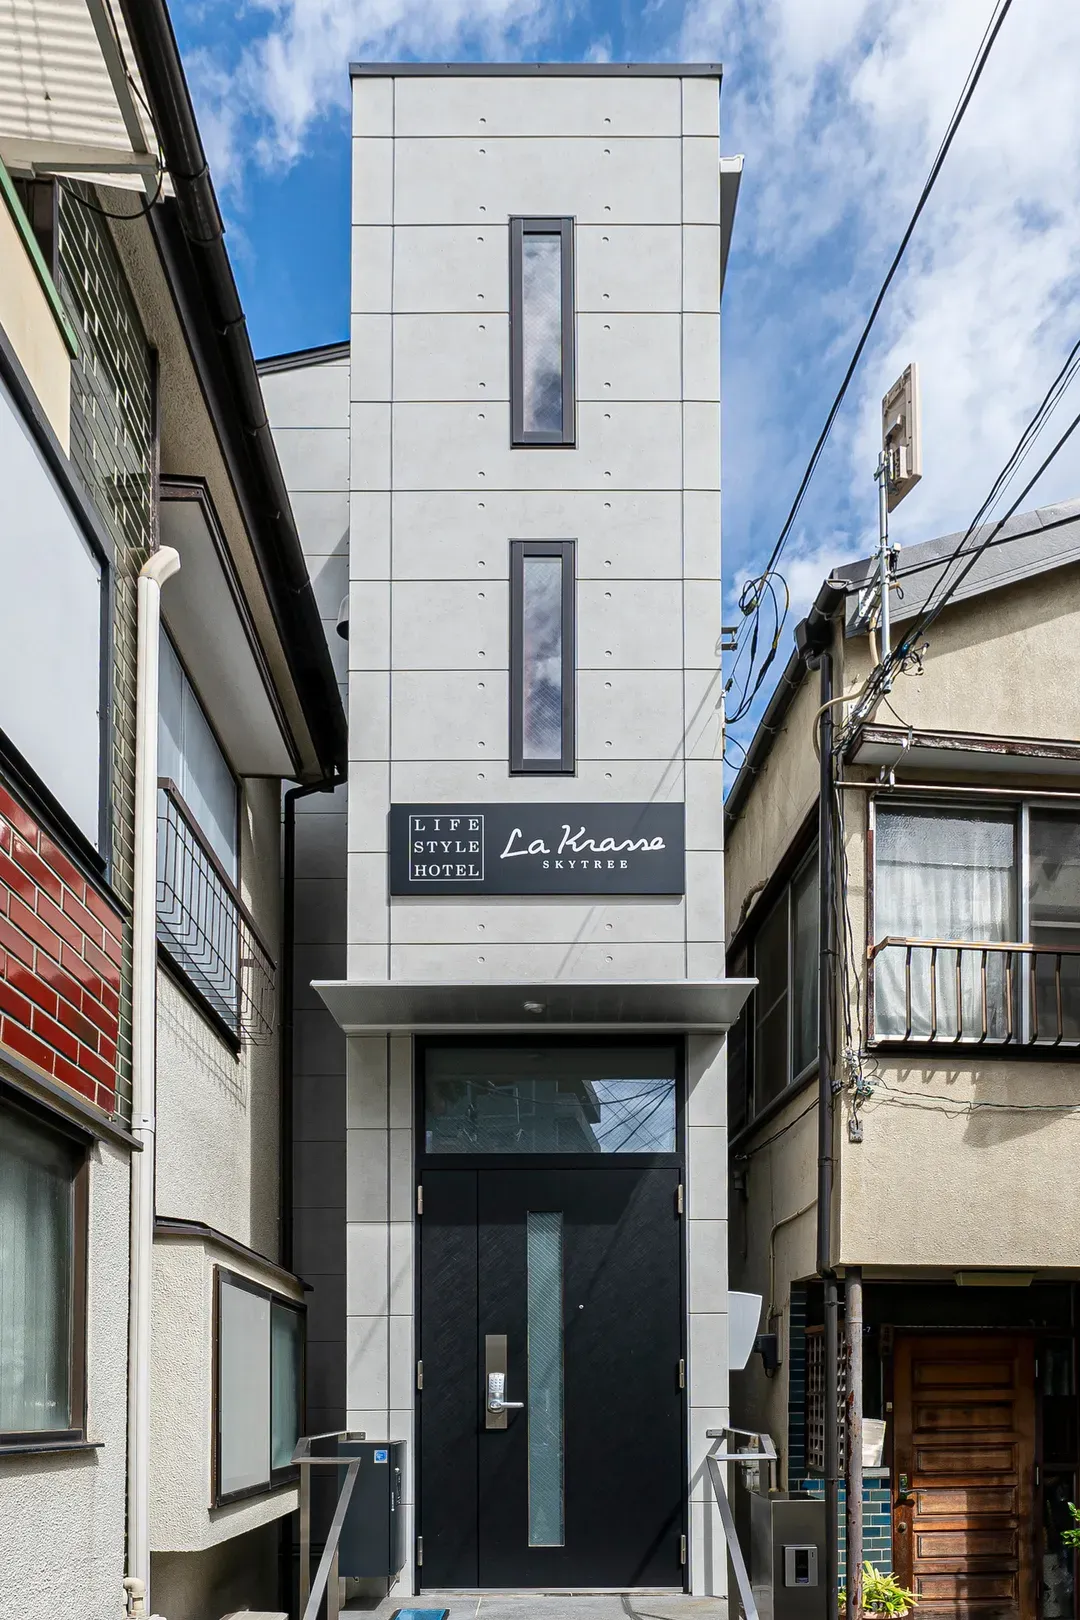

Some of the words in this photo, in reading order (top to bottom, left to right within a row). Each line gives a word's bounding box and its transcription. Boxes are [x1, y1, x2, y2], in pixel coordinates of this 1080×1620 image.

[413, 818, 480, 831] LIFE
[413, 840, 480, 854] STYLE
[499, 827, 551, 860] La
[413, 864, 480, 877] HOTEL
[542, 859, 628, 869] SKYTREE
